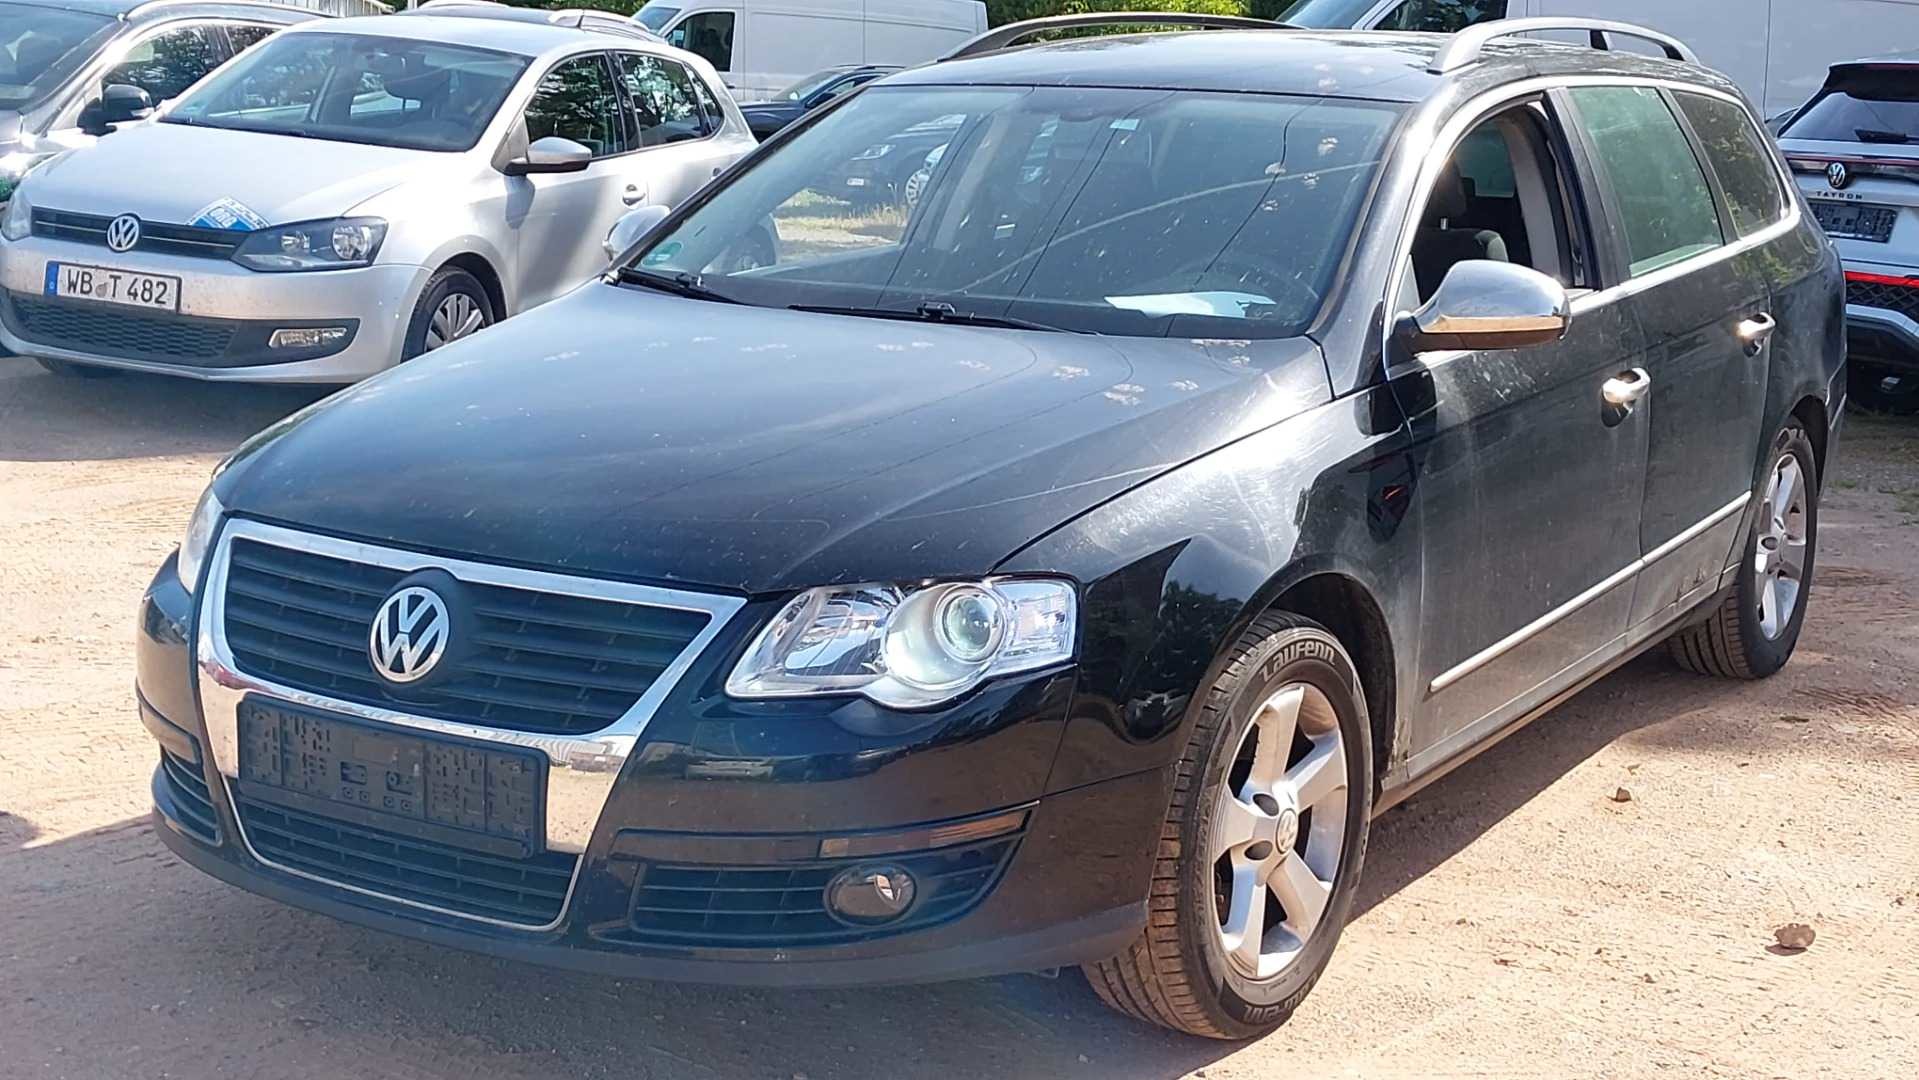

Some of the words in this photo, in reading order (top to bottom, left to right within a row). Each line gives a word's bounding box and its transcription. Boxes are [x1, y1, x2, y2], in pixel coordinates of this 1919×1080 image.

[1816, 191, 1863, 200] TAYRON
[107, 214, 141, 253] VW
[67, 269, 93, 295] WB
[109, 274, 122, 298] T
[126, 277, 168, 305] 482
[370, 586, 450, 683] VW
